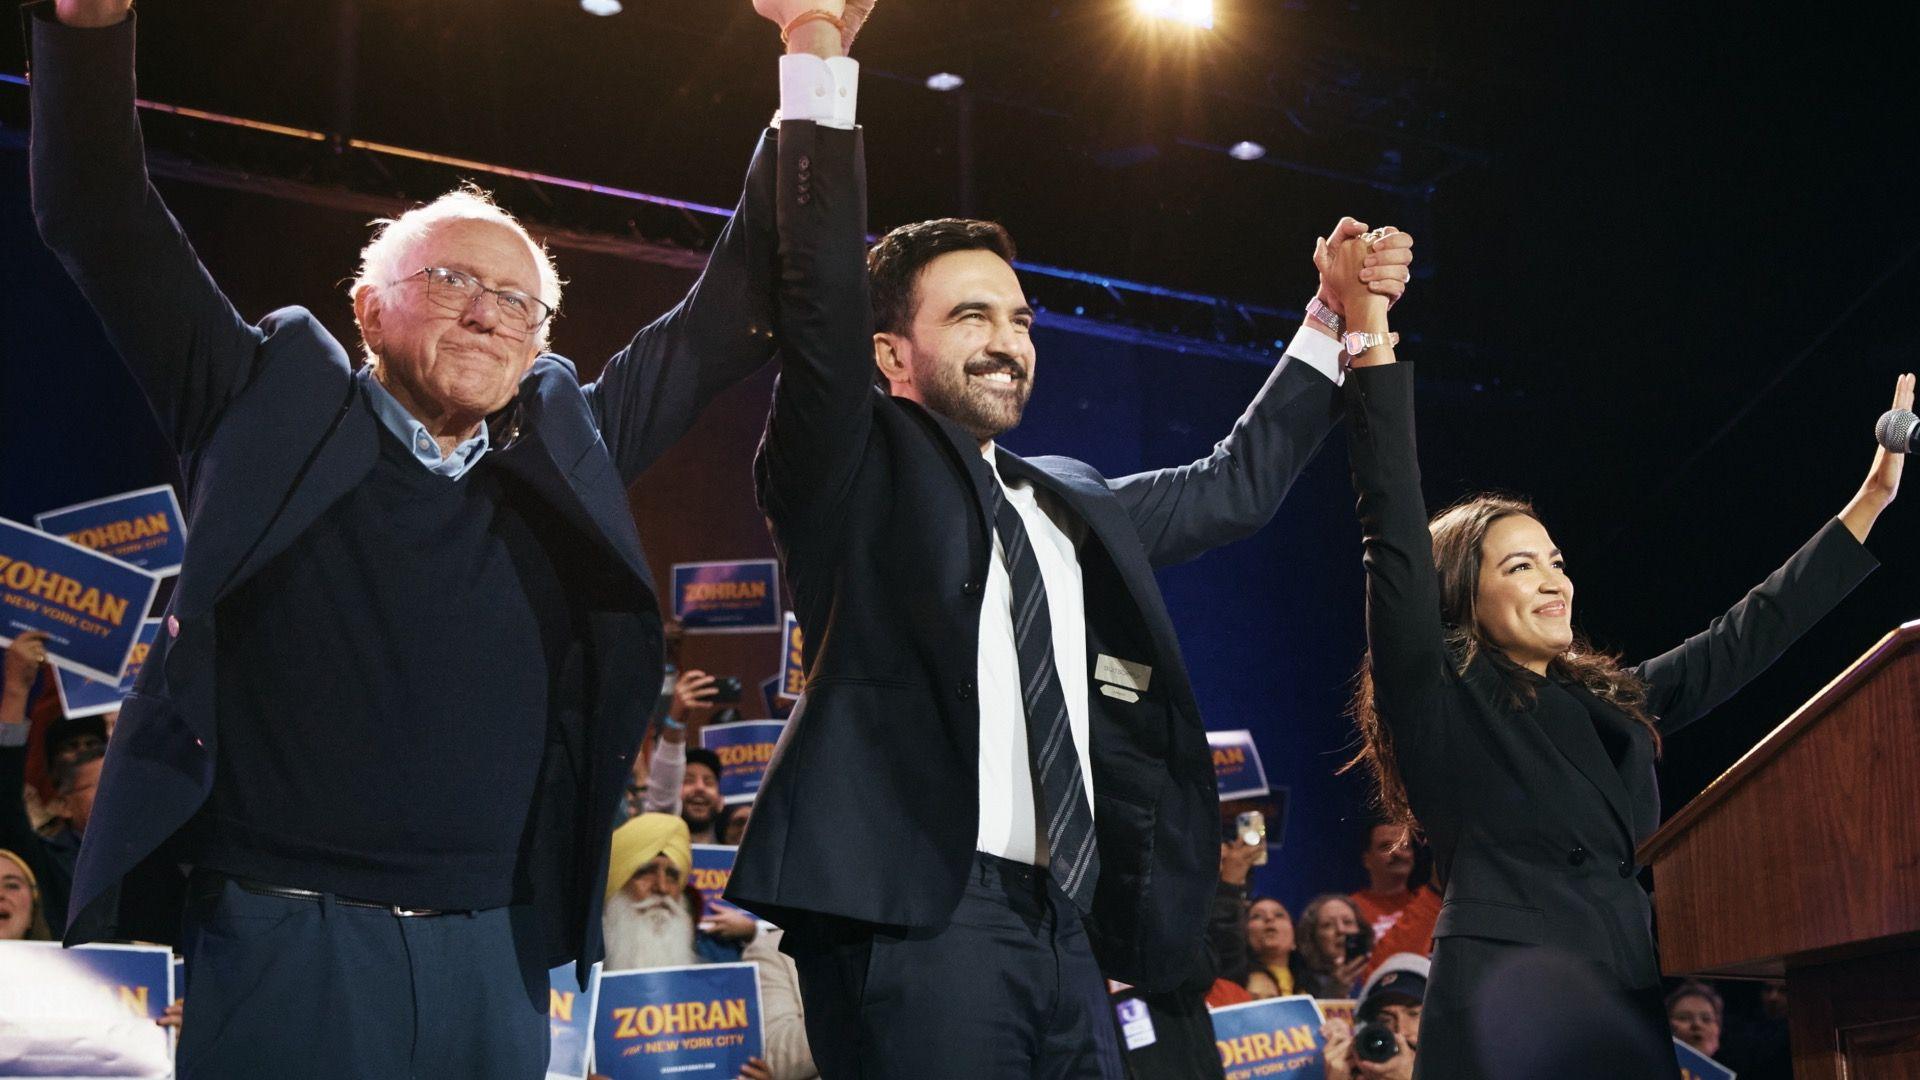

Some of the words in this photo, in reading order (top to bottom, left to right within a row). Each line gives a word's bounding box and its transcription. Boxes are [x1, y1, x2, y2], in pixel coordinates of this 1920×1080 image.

[4, 593, 39, 612] NEW
[41, 605, 80, 626] YORK
[80, 620, 110, 637] CITY
[612, 998, 749, 1040] ZOHRAN
[644, 1040, 679, 1055] NEW
[681, 1036, 715, 1051] YORK
[716, 1033, 745, 1048] CITY
